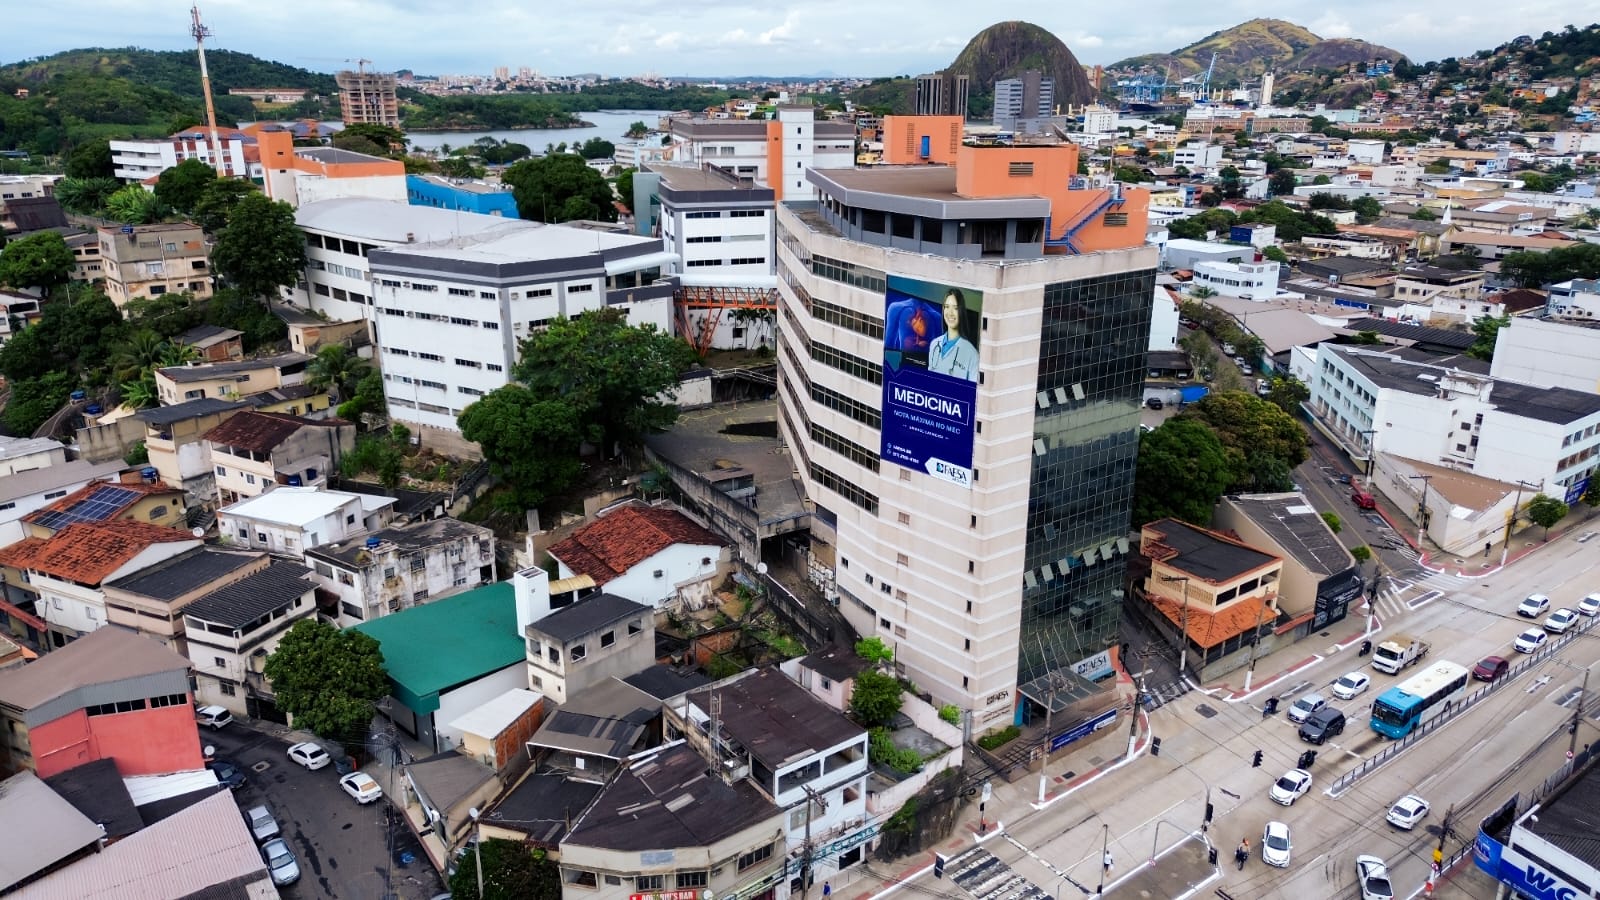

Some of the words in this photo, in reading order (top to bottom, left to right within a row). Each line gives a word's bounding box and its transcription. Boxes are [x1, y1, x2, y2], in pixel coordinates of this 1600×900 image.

[894, 387, 962, 418] MEDICINA
[893, 410, 910, 419] NOTA
[935, 421, 946, 430] NO
[944, 464, 967, 482] FAESA
[1084, 654, 1106, 672] FAESA
